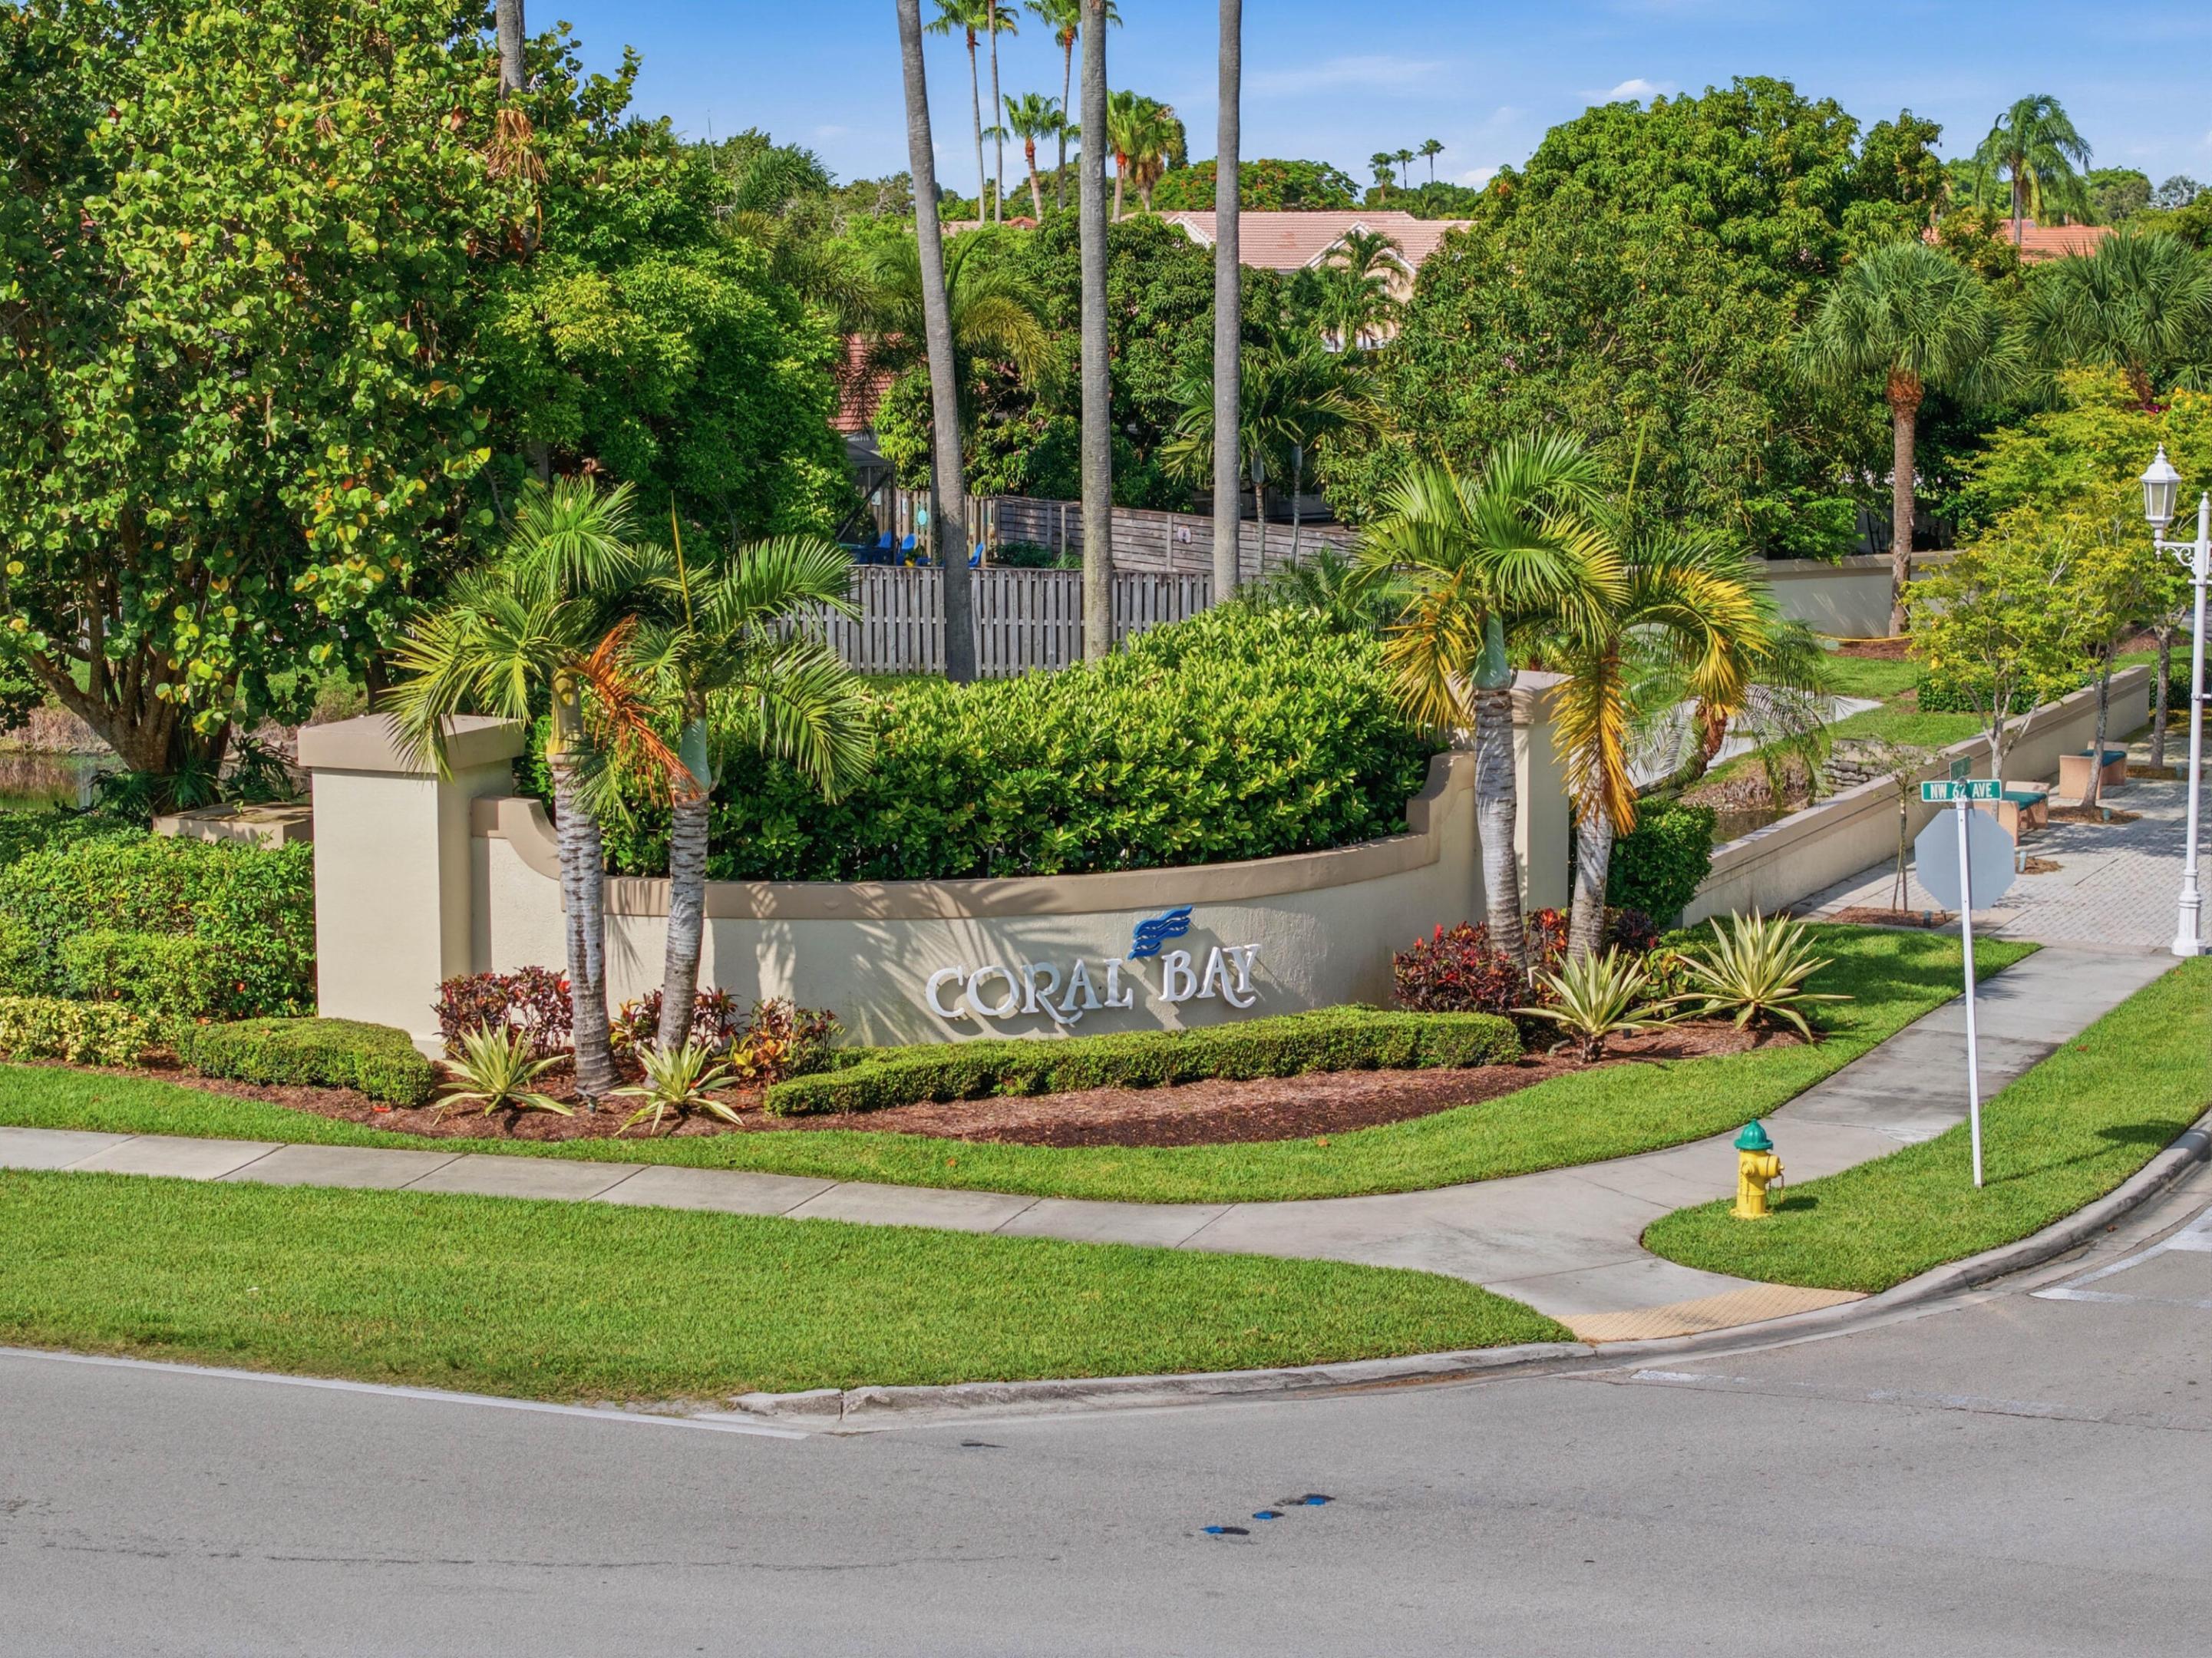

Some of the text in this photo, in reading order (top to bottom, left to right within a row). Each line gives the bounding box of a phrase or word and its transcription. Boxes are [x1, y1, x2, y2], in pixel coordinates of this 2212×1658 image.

[1930, 784, 1947, 799] NW
[1973, 783, 1992, 798] AVE
[926, 943, 1263, 1025] CORAL BAY
